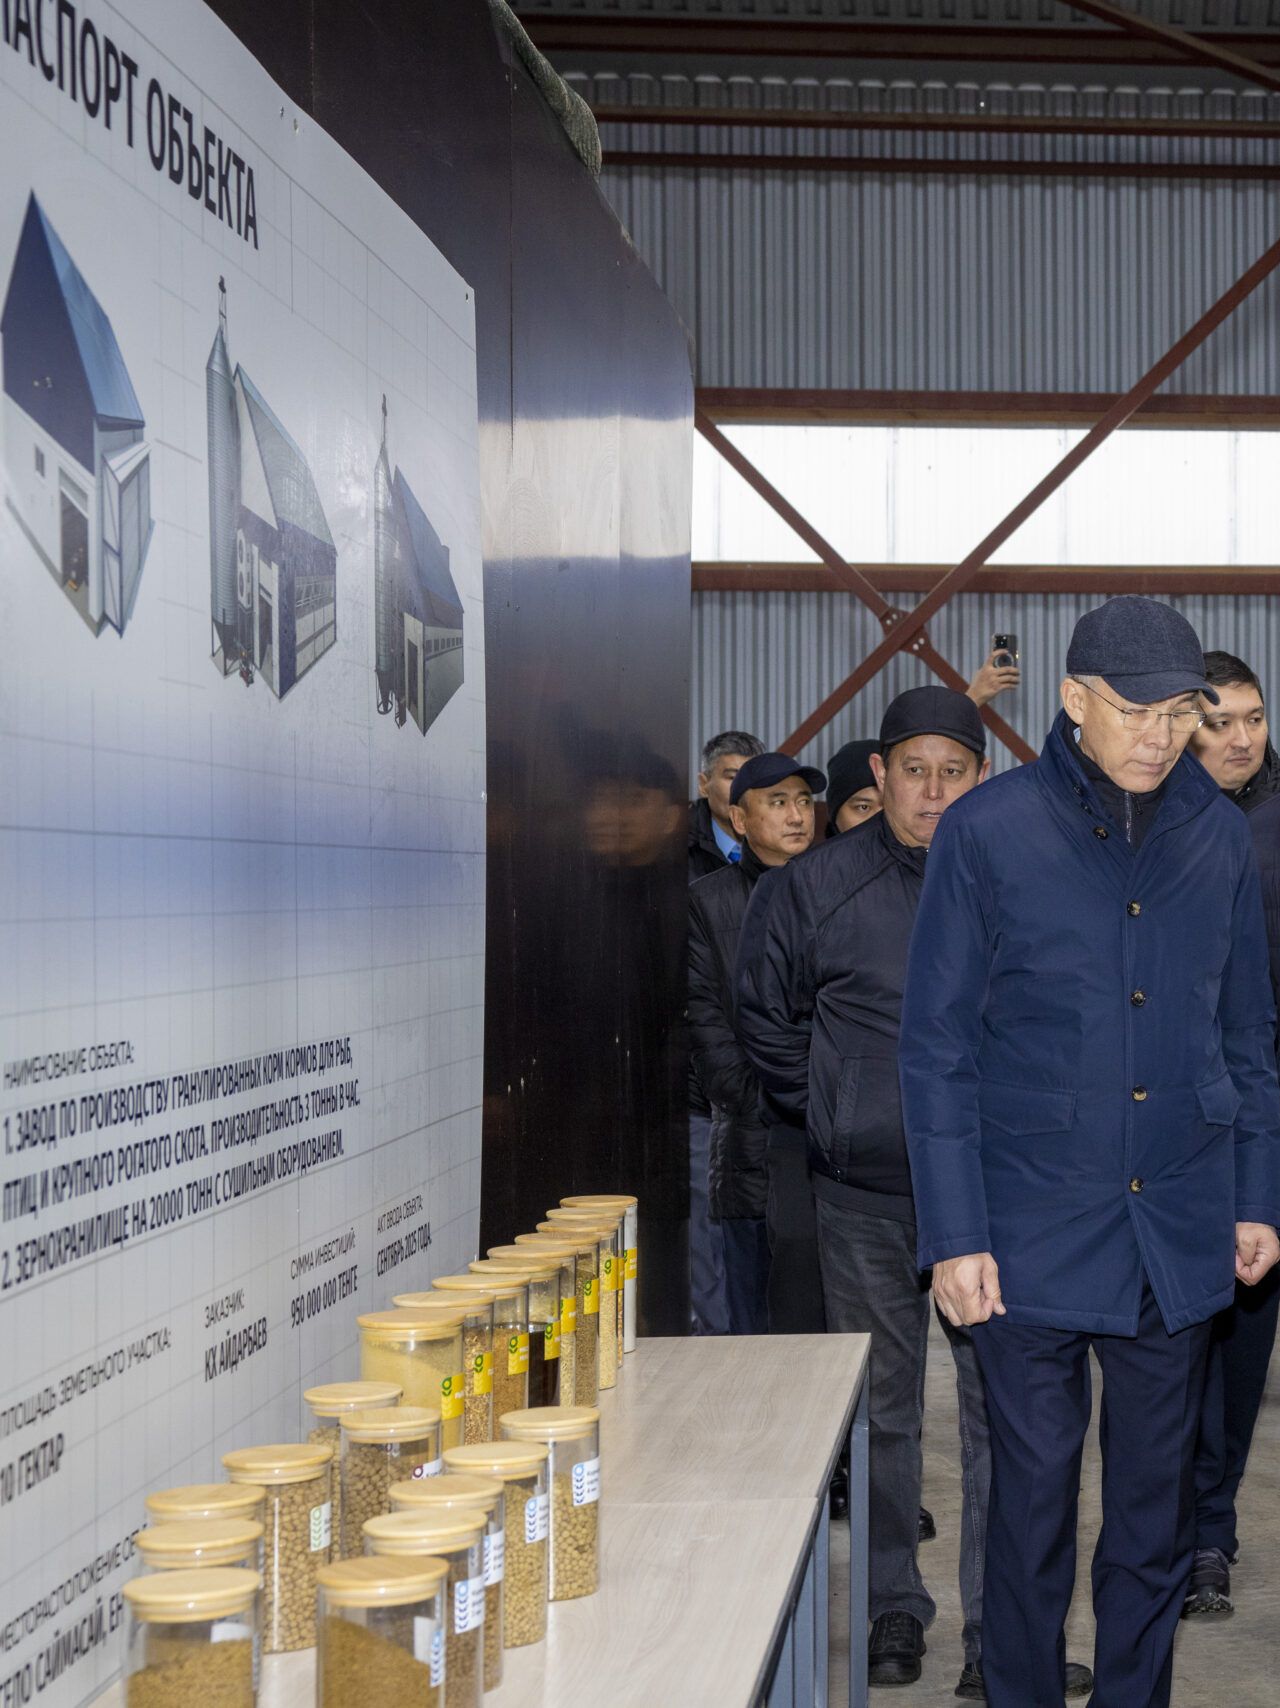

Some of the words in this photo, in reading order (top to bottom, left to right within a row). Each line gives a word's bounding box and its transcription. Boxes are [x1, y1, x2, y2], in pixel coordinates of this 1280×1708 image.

[147, 78, 259, 250] ОБЪЕКТА
[16, 1103, 57, 1151] ЗАВОД
[60, 1099, 77, 1138] ПО
[80, 1078, 170, 1134] ПРОИЗВОДСТВУ
[172, 1057, 262, 1110] ГРАНУЛИРОВАННЫХ
[263, 1051, 284, 1086] КОРМ
[285, 1044, 317, 1079] КОРМОВ
[318, 1040, 335, 1076] ДЛЯ
[3, 1173, 38, 1223] ПТИЦ
[40, 1169, 49, 1210] И
[52, 1150, 115, 1205] КРУПНОГО
[118, 1134, 172, 1183] РОГАТОГО
[211, 1094, 304, 1154] ПРОИЗВОДИТЕЛЬНОСТЬ
[304, 1093, 310, 1121] 3
[311, 1085, 338, 1119] ТОННЫ
[339, 1083, 344, 1110] В
[15, 1205, 129, 1284] ЗЕРНОХРАНИЛИЩЕ
[132, 1199, 147, 1237] НА
[150, 1187, 184, 1230] 20000
[186, 1176, 213, 1216] ТОНН
[215, 1173, 221, 1205] С
[223, 1152, 275, 1202] СУШИЛЬНЫМ
[205, 1345, 218, 1383] КХ
[219, 1317, 267, 1374] АЙДАРБАЕВ
[291, 1294, 304, 1328] 950
[307, 1285, 321, 1319] 000
[323, 1277, 337, 1310] 000
[338, 1264, 358, 1301] ТЕНГЕ
[18, 1433, 64, 1496] ГЕКТАР
